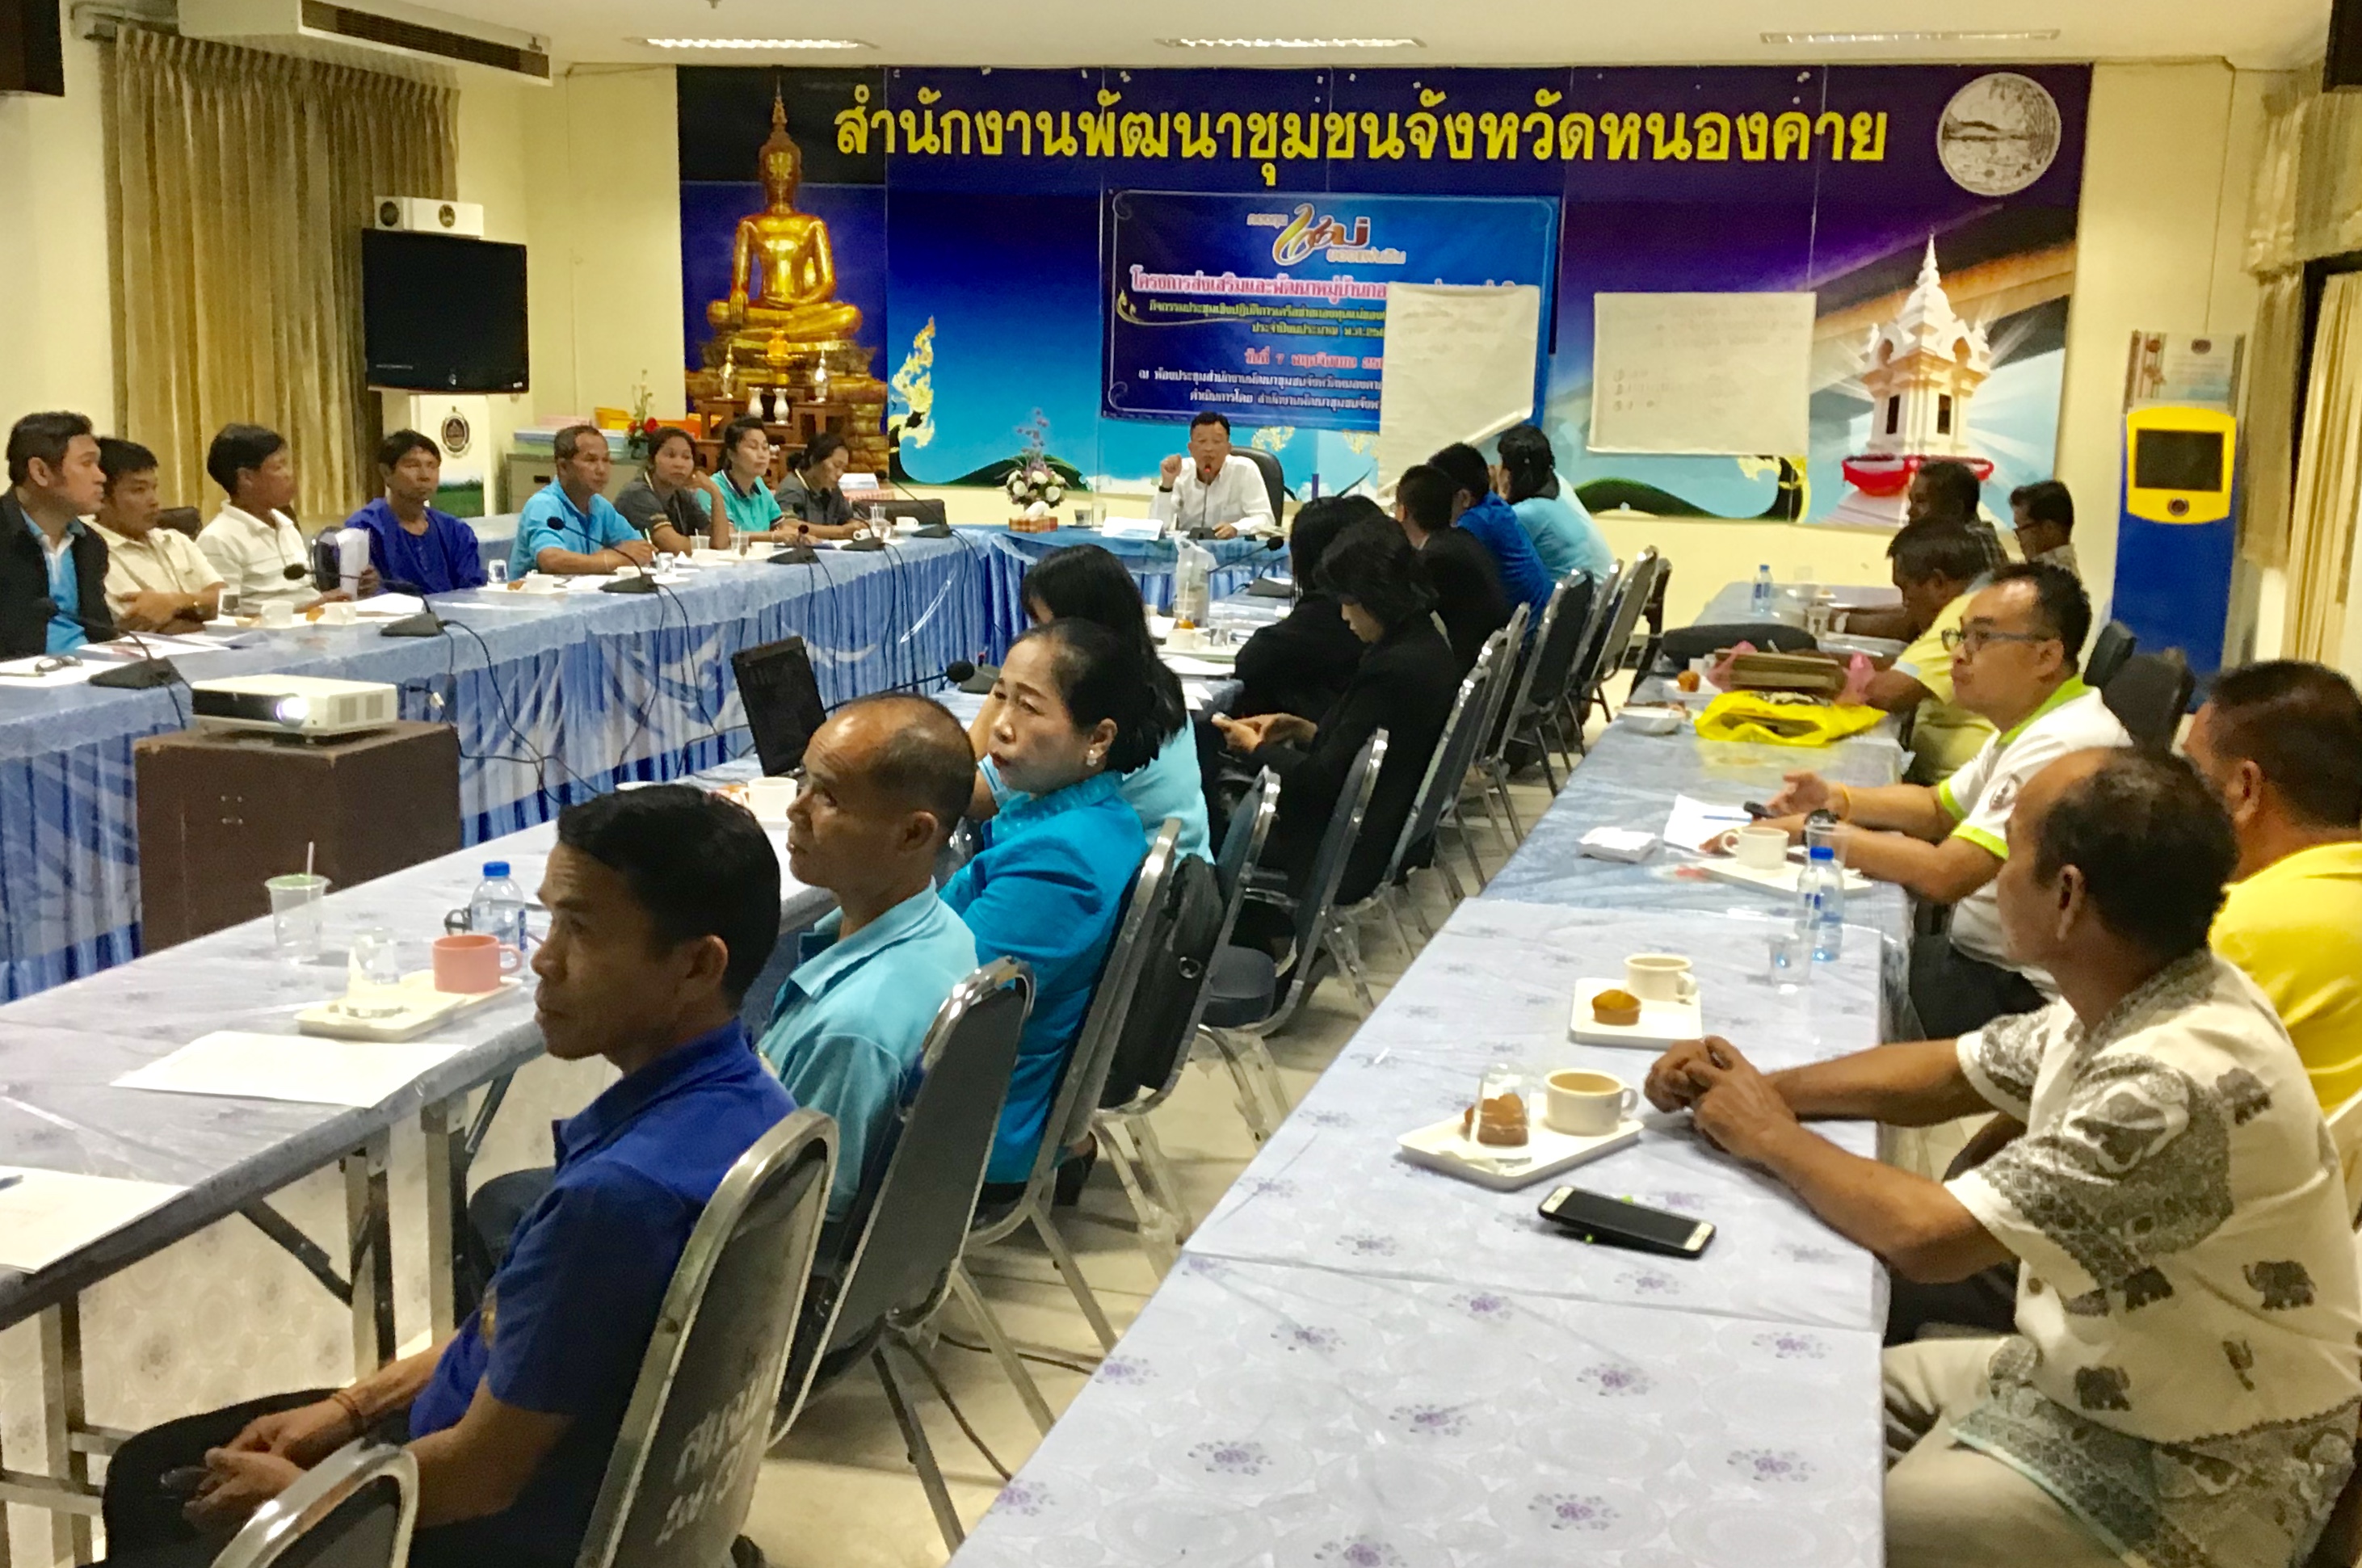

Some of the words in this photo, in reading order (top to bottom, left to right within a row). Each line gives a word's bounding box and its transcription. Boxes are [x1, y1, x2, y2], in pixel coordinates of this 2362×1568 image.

[834, 84, 1888, 187] สำนักงานพัฒนาชุมชนจังหวัดหนองคาย
